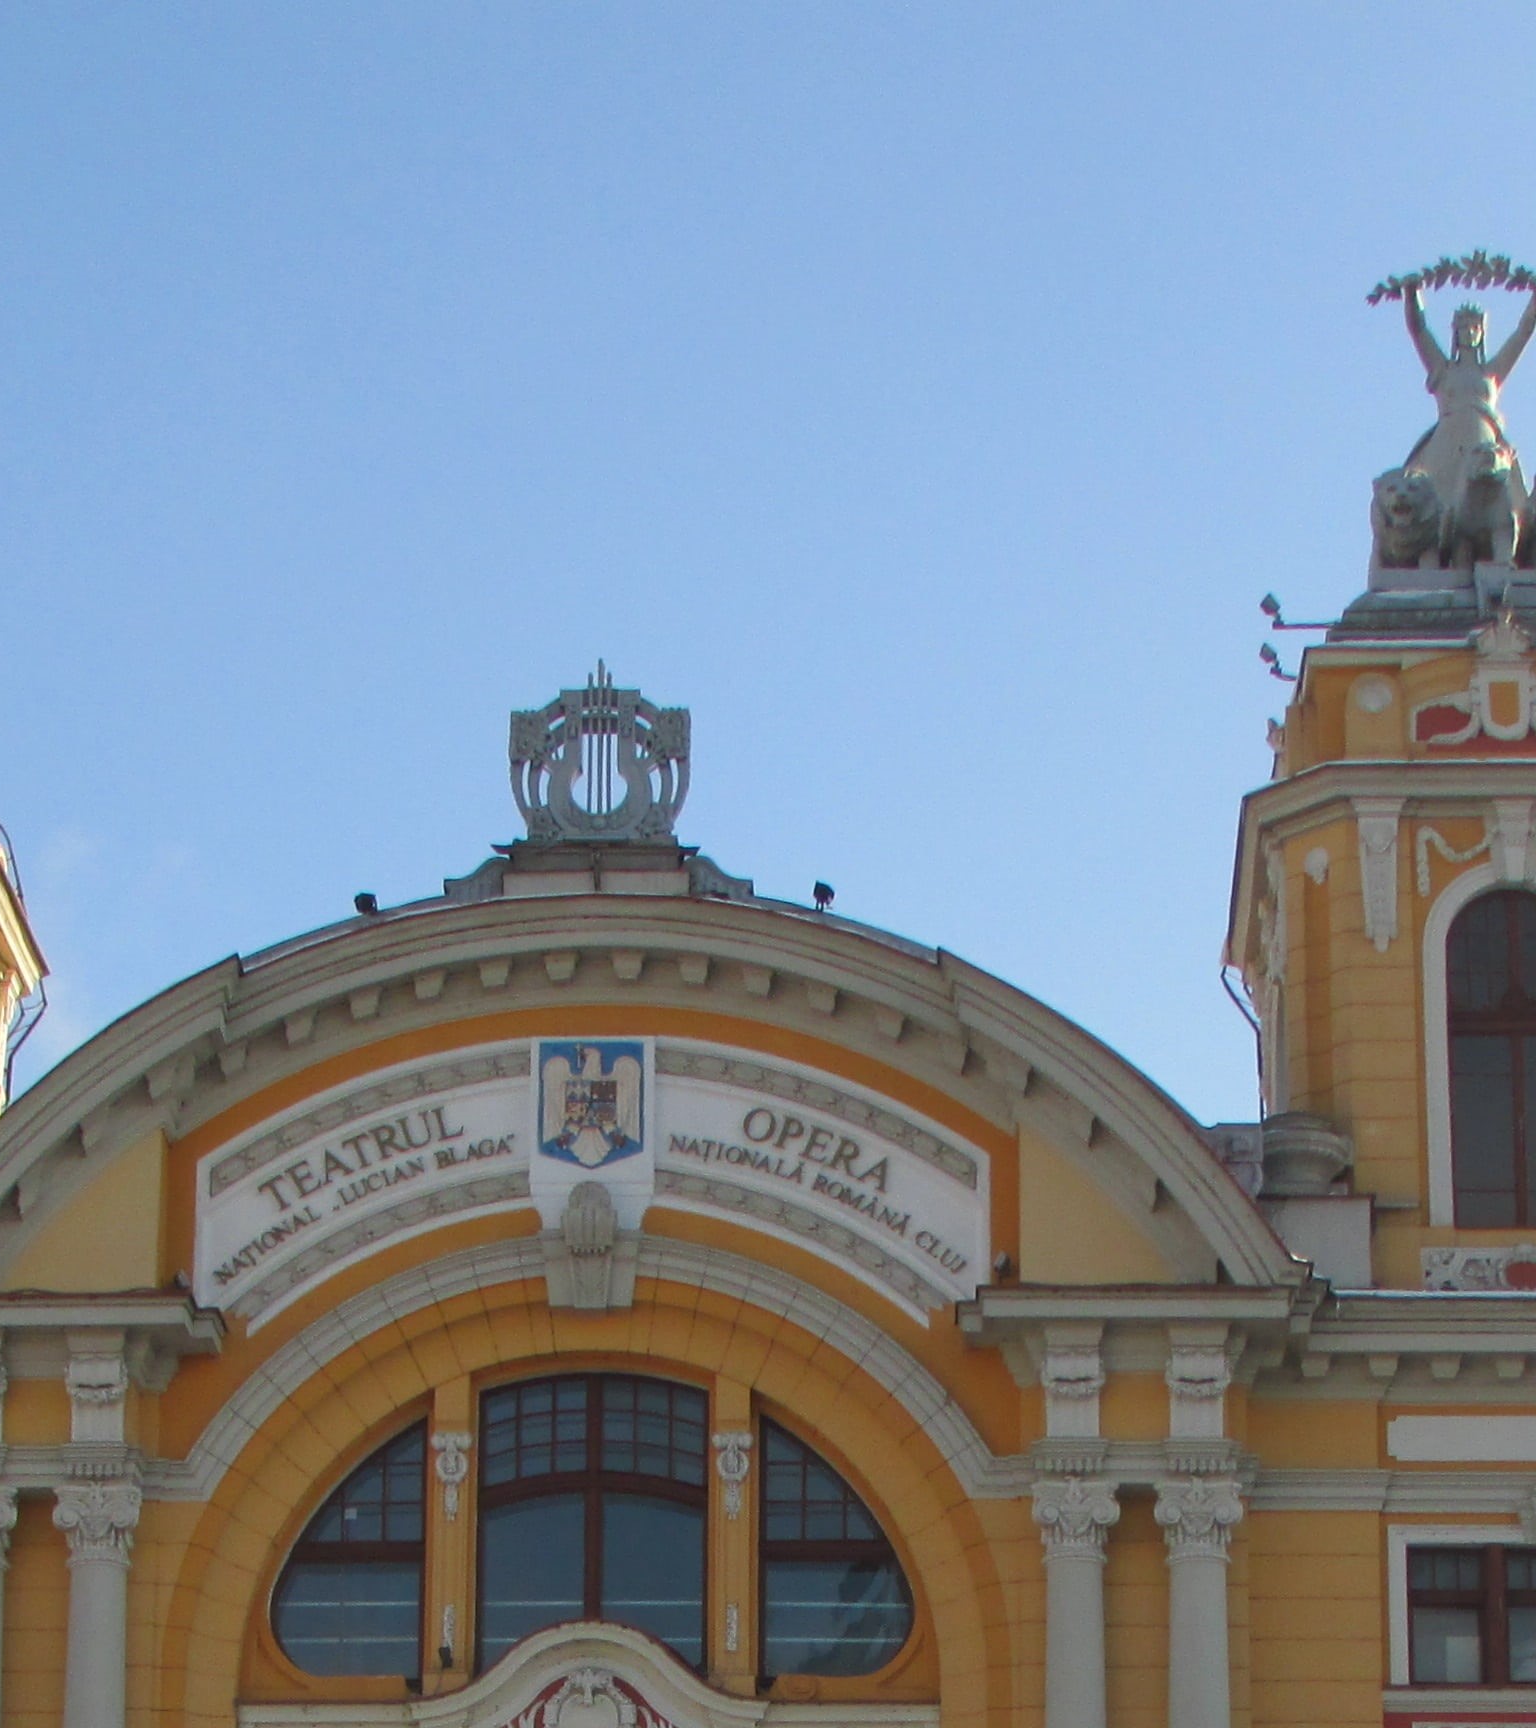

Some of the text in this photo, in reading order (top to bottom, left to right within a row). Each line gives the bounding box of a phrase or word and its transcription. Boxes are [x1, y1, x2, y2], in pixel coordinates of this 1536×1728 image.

[257, 1106, 464, 1212] TEATRUL
[742, 1107, 889, 1194] OPERA
[915, 1230, 968, 1274] CLUJ
